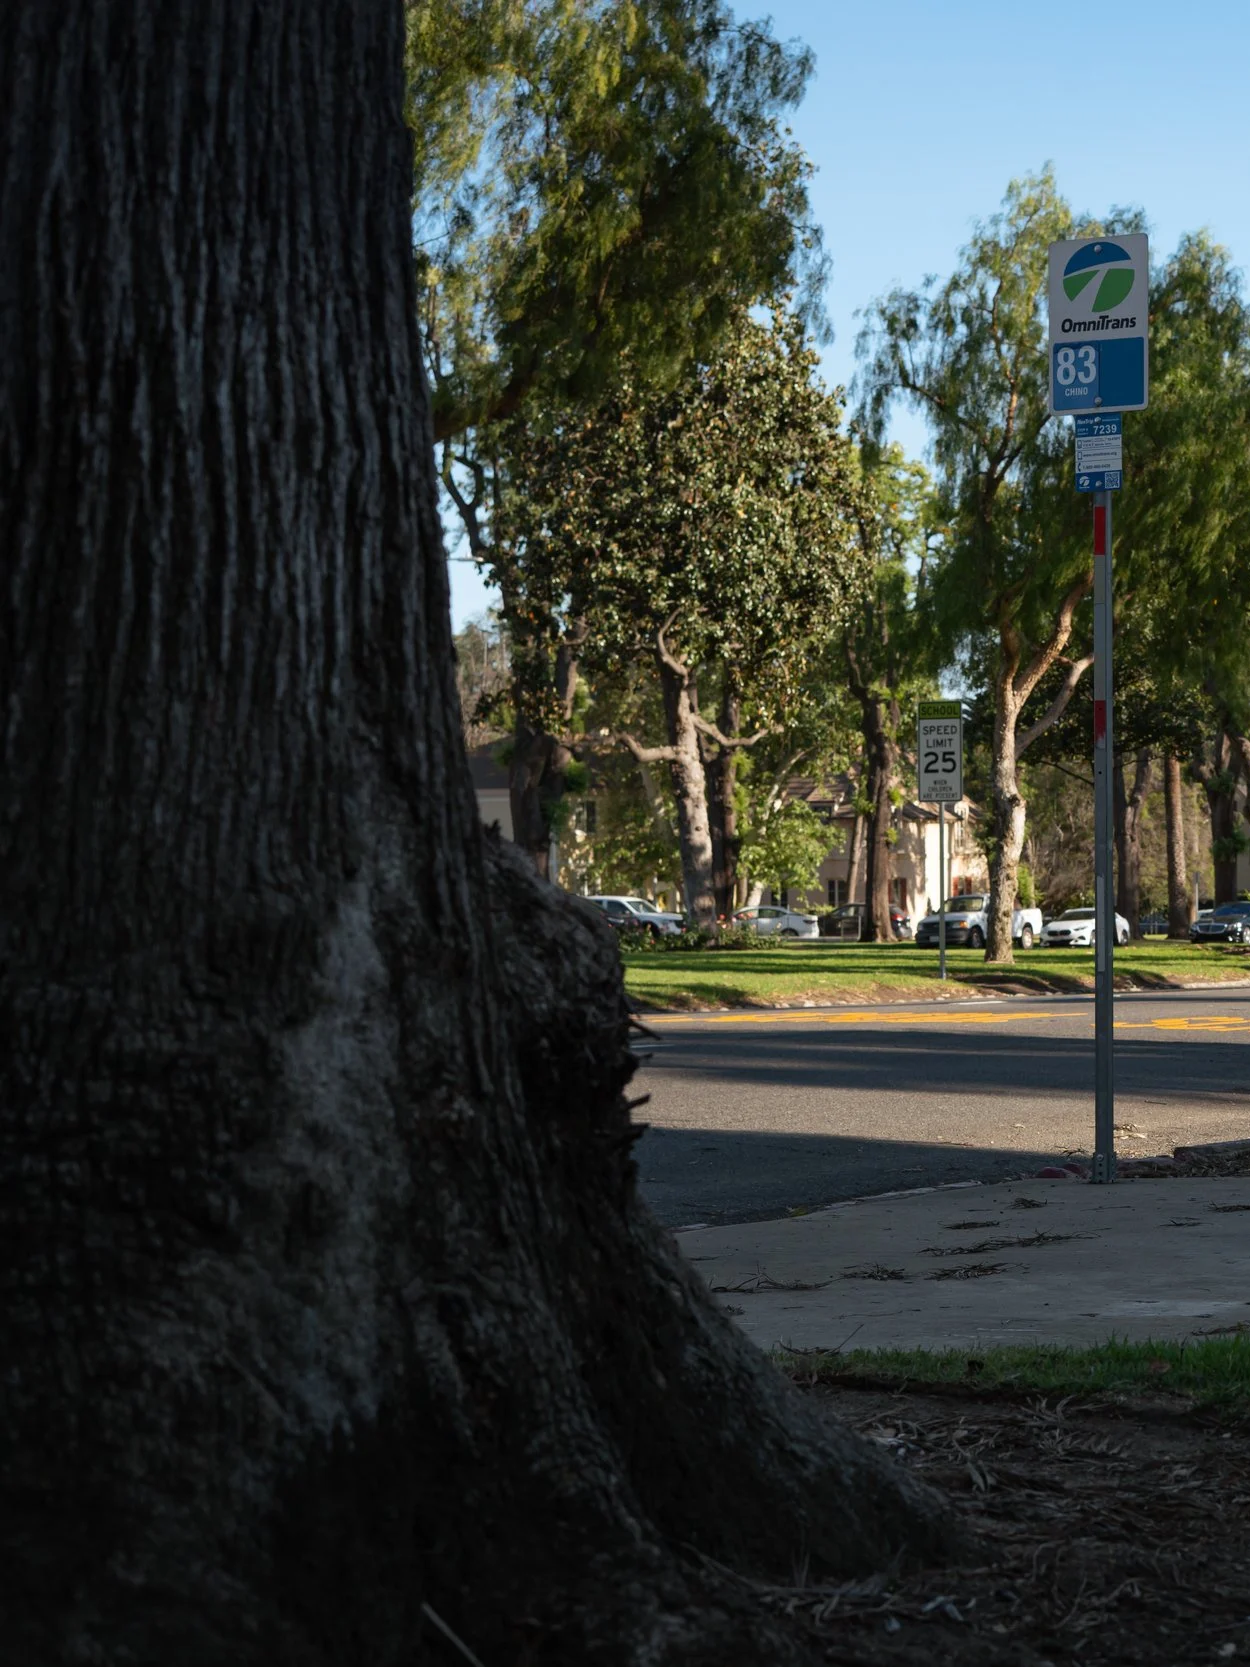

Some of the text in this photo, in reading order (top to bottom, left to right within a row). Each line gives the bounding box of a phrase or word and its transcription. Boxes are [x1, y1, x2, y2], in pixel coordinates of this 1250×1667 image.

[1061, 315, 1137, 333] OmniTrans
[1056, 345, 1097, 385] 83
[1064, 386, 1089, 397] CHINO
[1093, 424, 1117, 435] 7239
[921, 706, 958, 716] SCHOOL
[922, 725, 958, 735] SPEED
[926, 738, 953, 749] LIMIT
[924, 751, 957, 774] 25
